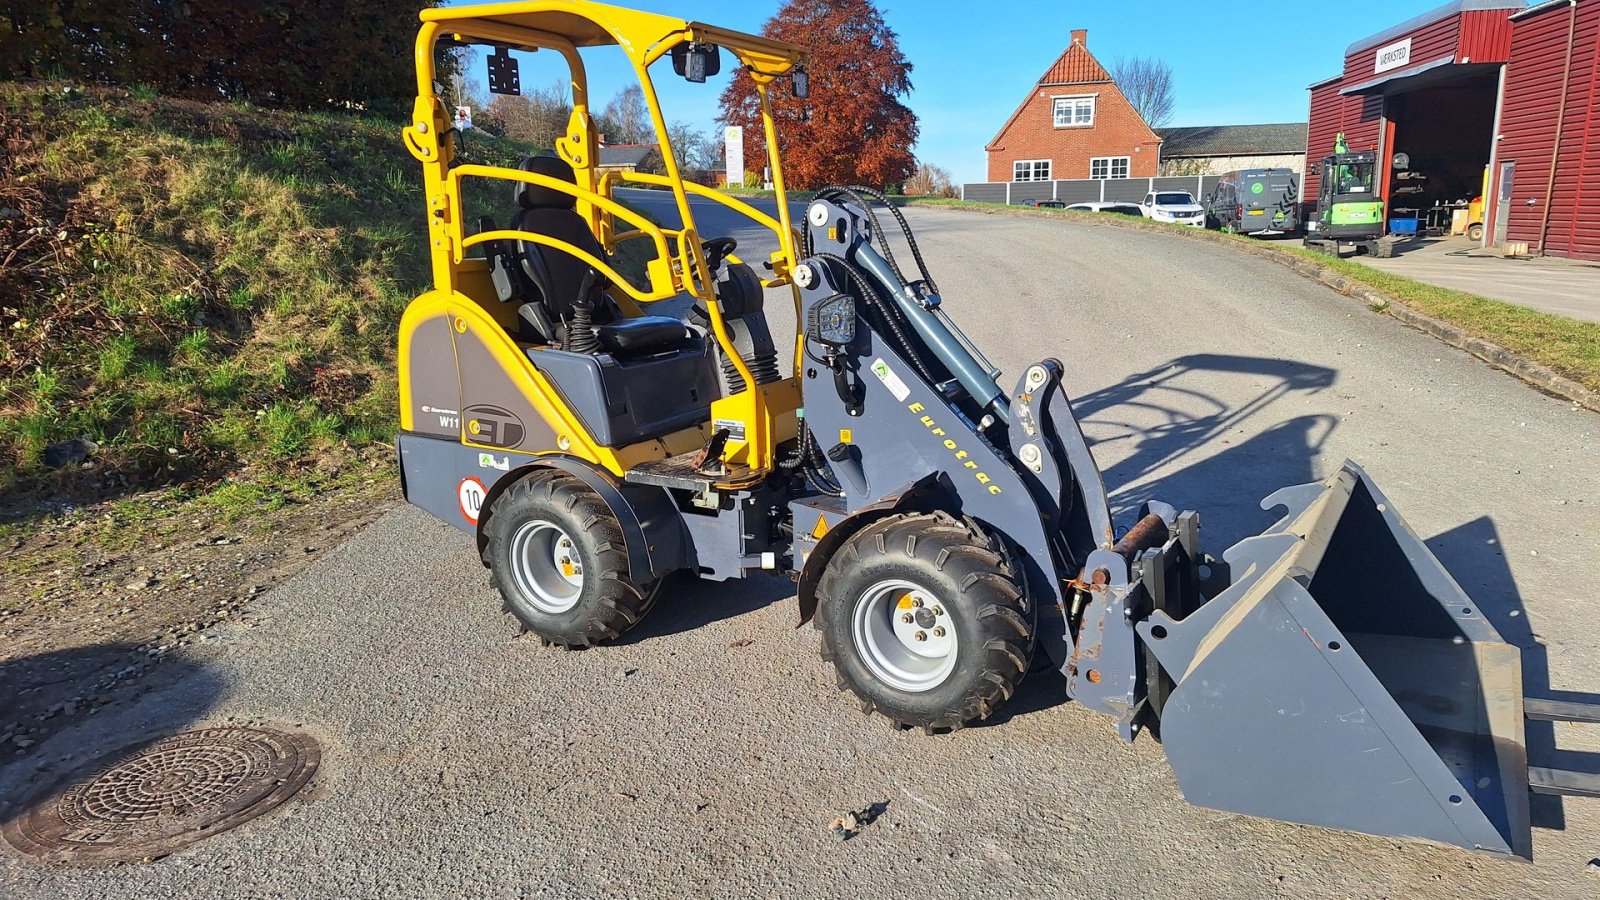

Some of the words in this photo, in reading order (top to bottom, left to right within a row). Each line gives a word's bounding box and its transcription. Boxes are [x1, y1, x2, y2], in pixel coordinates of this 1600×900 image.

[439, 415, 459, 429] W11
[907, 402, 1002, 495] Eurotrac
[466, 489, 480, 511] 10
